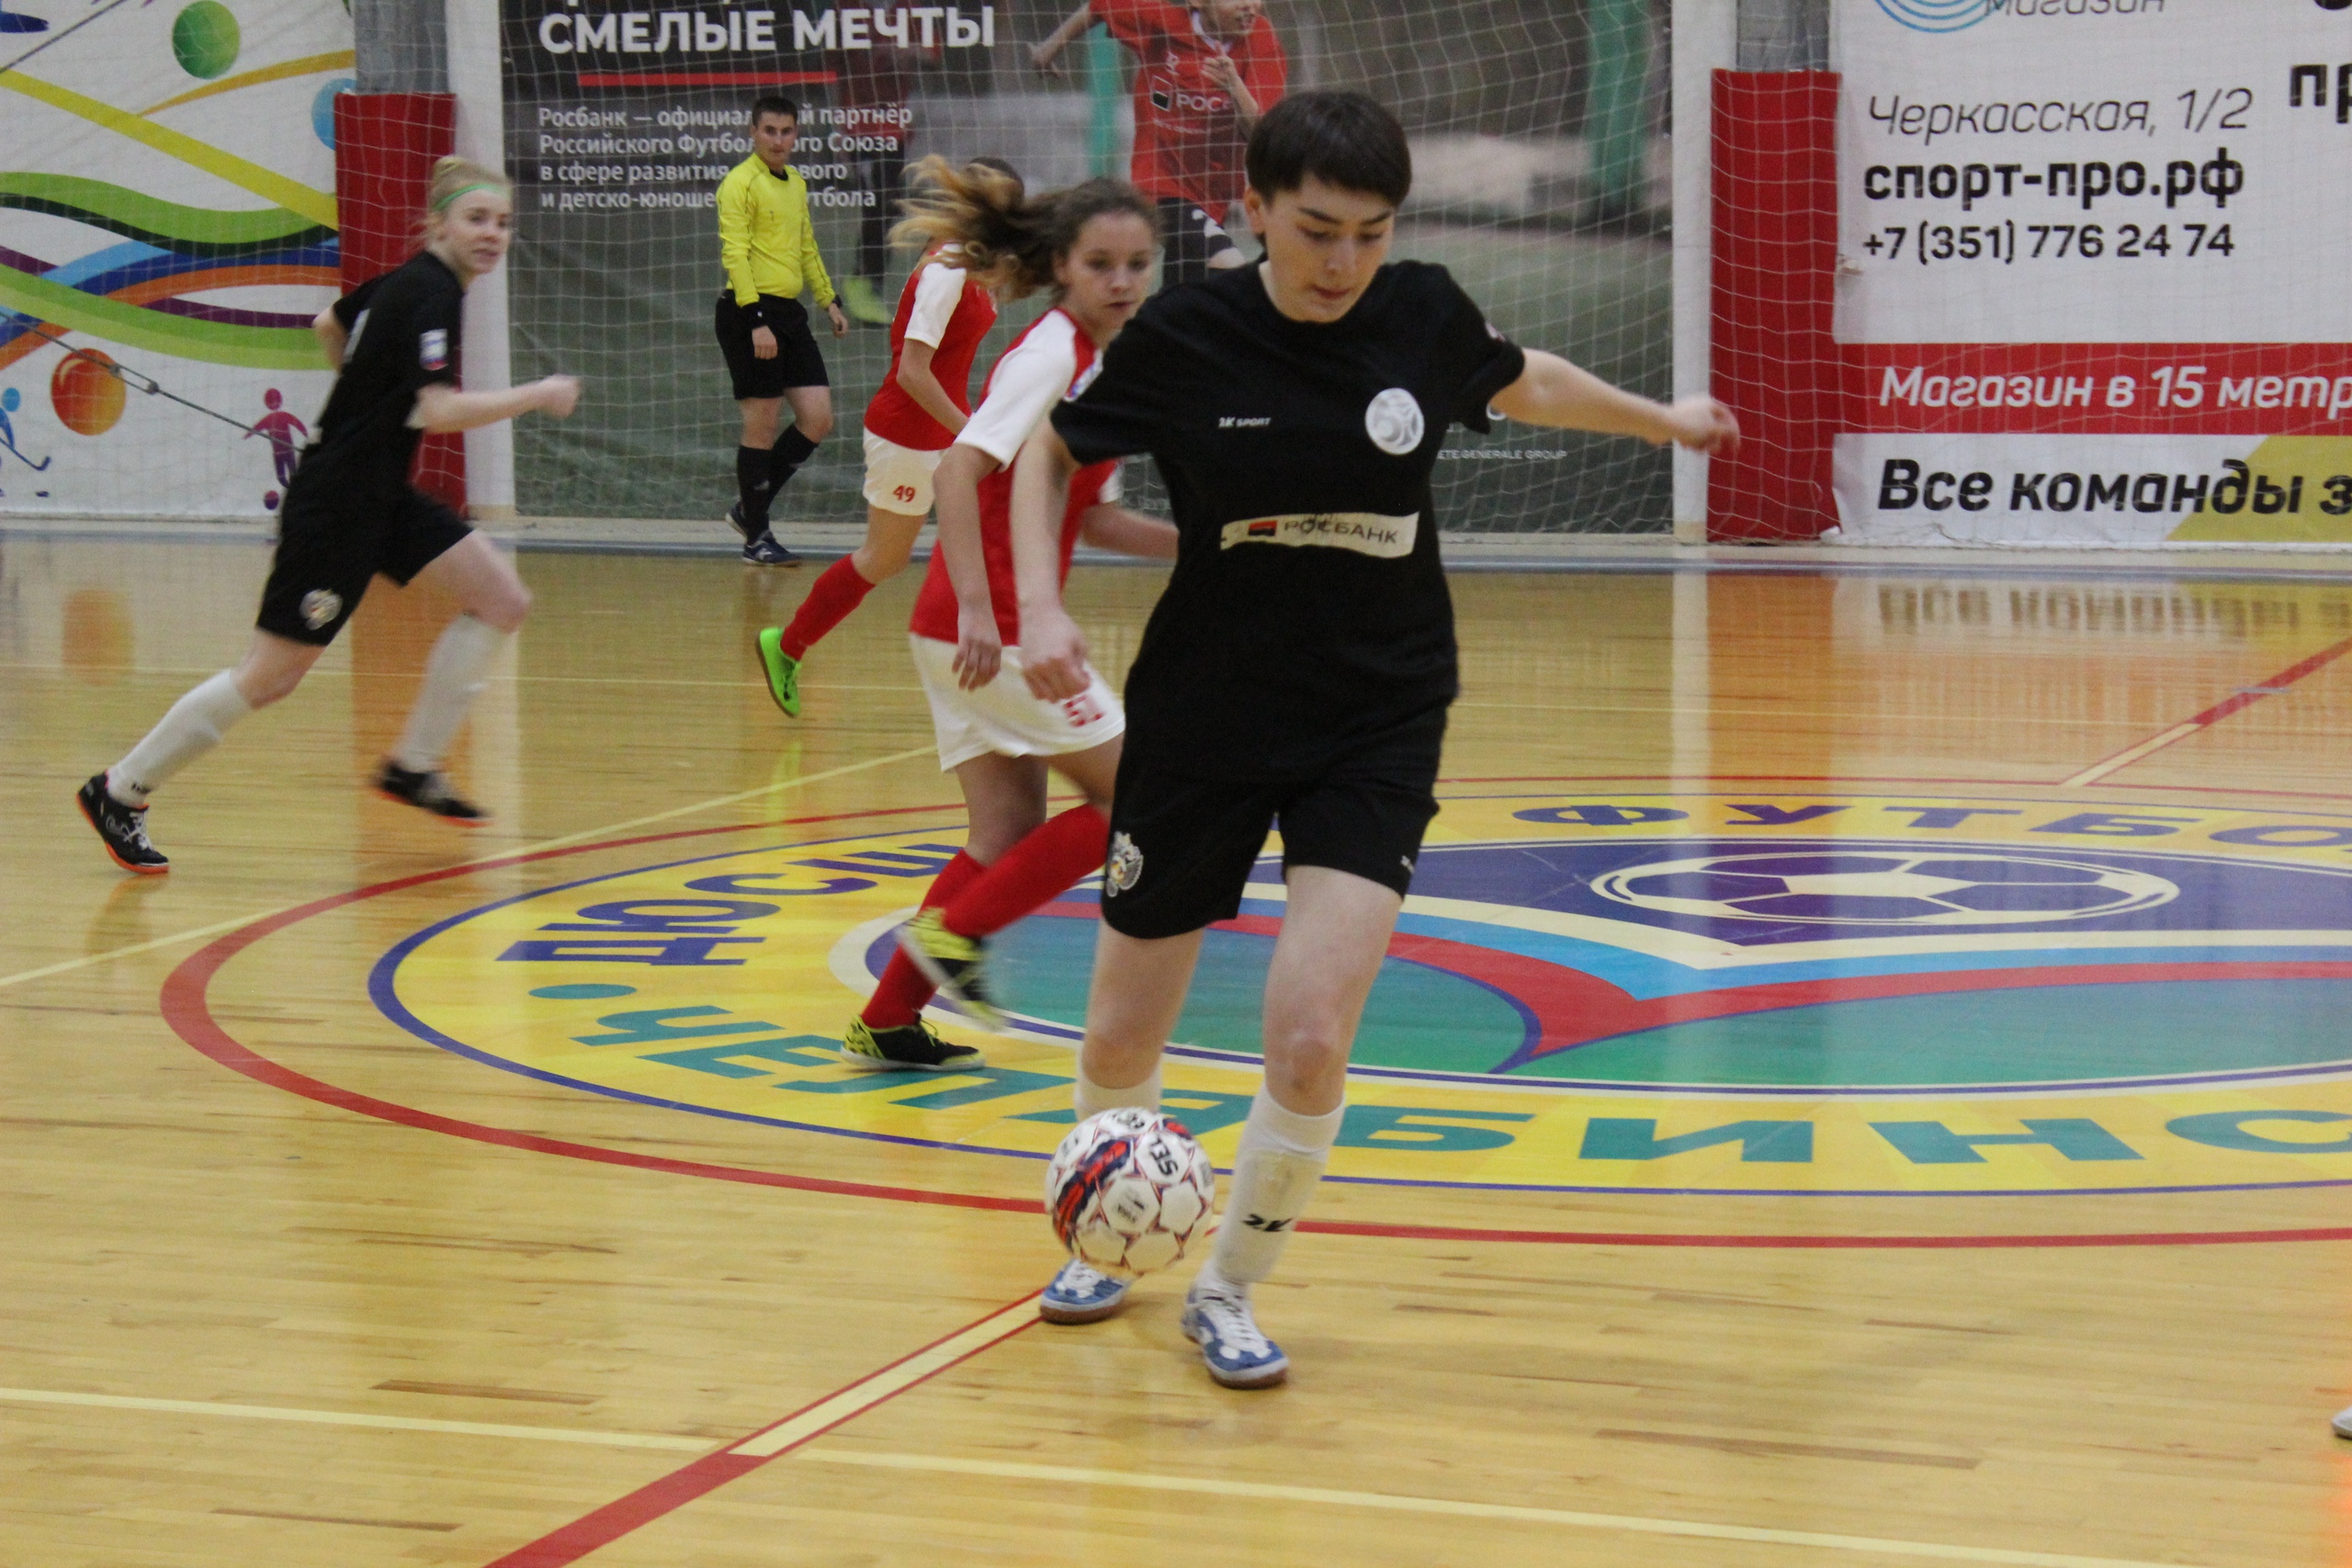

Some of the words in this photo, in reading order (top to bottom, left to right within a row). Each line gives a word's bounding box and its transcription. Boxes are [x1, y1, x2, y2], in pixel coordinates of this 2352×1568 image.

[538, 11, 776, 54] СМЕЛЫЕ
[793, 6, 995, 51] МЕЧТЫ
[538, 106, 628, 128] Росбанк
[820, 103, 913, 130] партнёр
[1869, 95, 2155, 146] Черкасская,
[2177, 87, 2254, 133] 1/2
[539, 132, 673, 154] Российского
[828, 132, 898, 152] Союза
[540, 165, 553, 181] в
[558, 160, 624, 186] сфере
[629, 164, 729, 186] развития
[1863, 147, 2245, 211] спорт-про.рф
[541, 192, 555, 208] и
[1863, 227, 1907, 260] +7
[1917, 220, 2016, 265] (351)
[2027, 223, 2104, 259] 776
[2117, 224, 2172, 258] 24
[2182, 223, 2235, 258] 74
[1879, 367, 2095, 408] Магазин
[2105, 375, 2135, 408] в
[2151, 366, 2208, 408] 15
[1461, 449, 1522, 459] GENERALE
[1525, 449, 1567, 459] GROUP
[892, 485, 917, 502] 49
[1877, 458, 1993, 512] Все
[2009, 458, 2303, 514] команды
[1283, 519, 1399, 544] РОСБАНК
